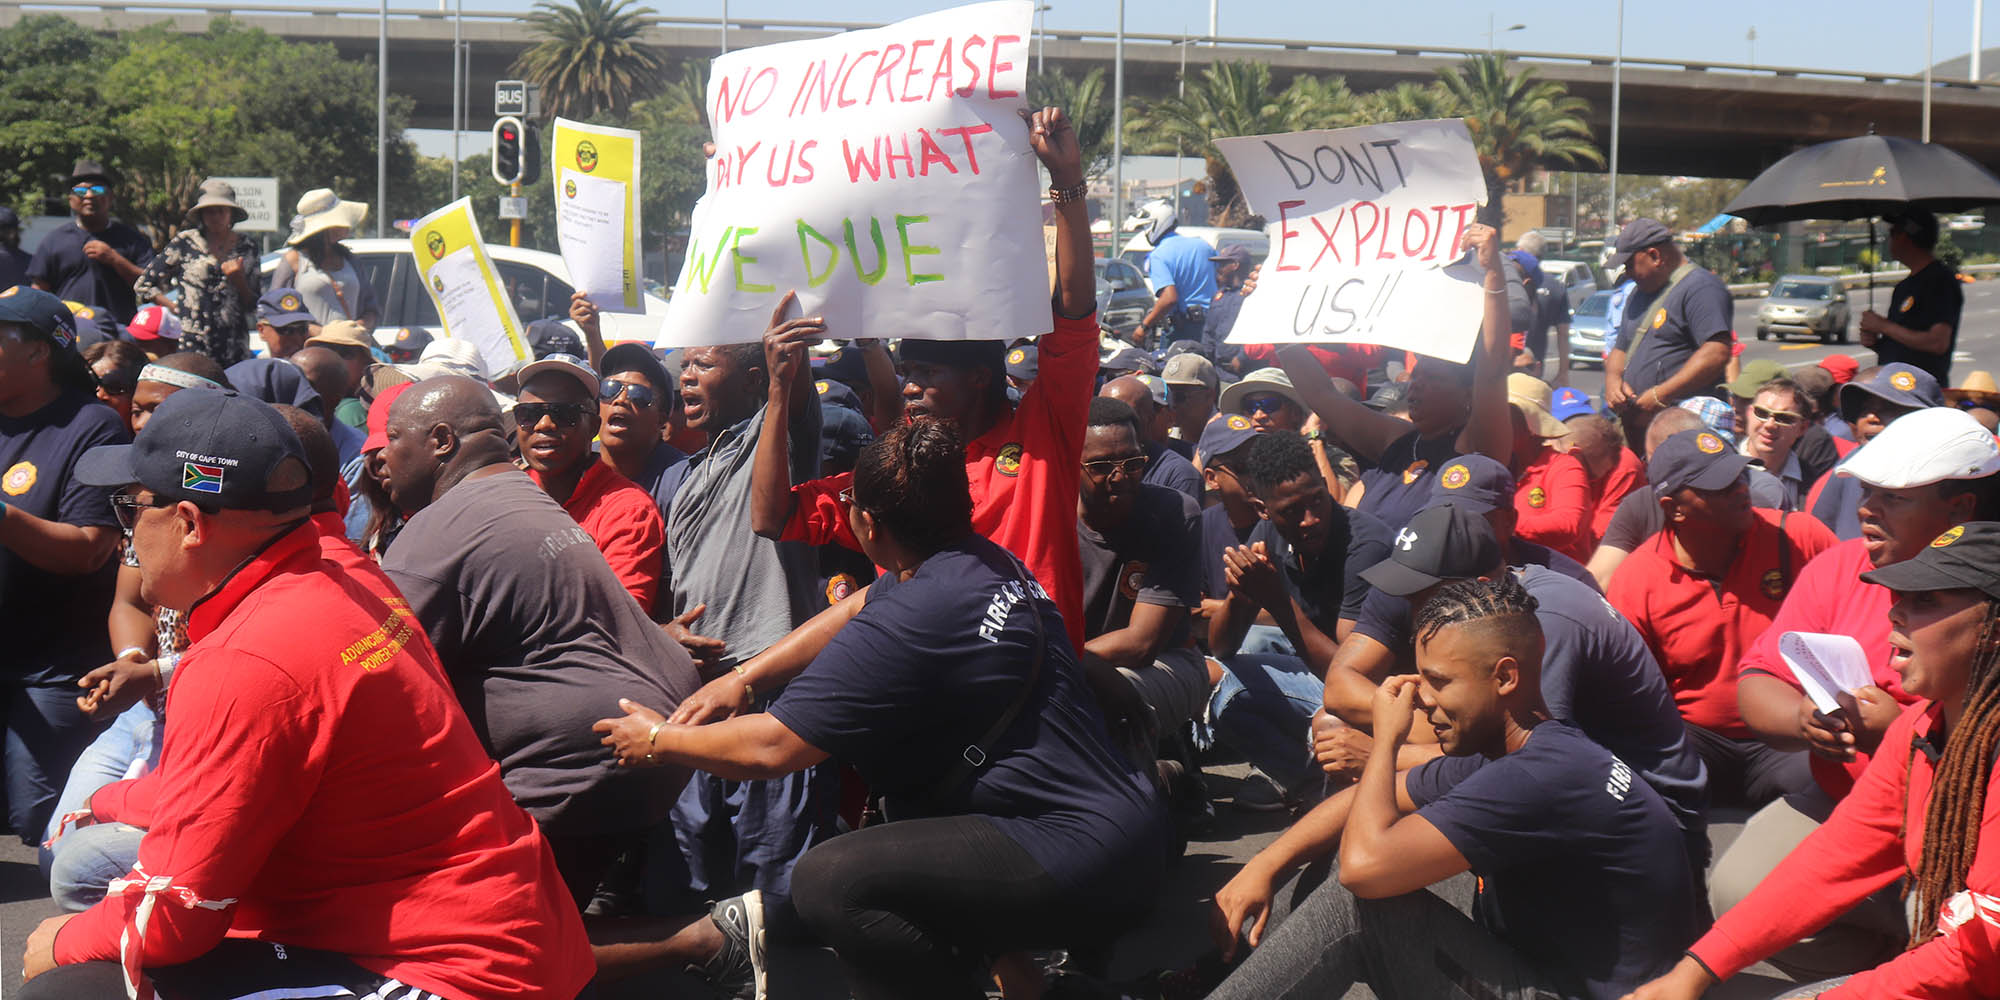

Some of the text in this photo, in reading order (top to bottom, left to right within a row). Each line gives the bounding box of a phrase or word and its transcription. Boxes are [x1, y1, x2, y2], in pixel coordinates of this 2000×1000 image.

[497, 89, 522, 104] BUS
[715, 34, 1021, 124] NO INCREASE
[766, 139, 818, 187] US
[842, 122, 993, 183] WHAT
[1264, 139, 1406, 192] DONT
[685, 214, 945, 295] WE DUE
[1275, 200, 1476, 272] EXPLOIT
[1293, 270, 1404, 336] US!!
[176, 450, 239, 467] CITY OF CAPE TOWN
[978, 593, 1012, 643] FIRE
[1001, 584, 1019, 604] &
[340, 629, 387, 666] ADVANCING
[359, 647, 394, 672] POWER
